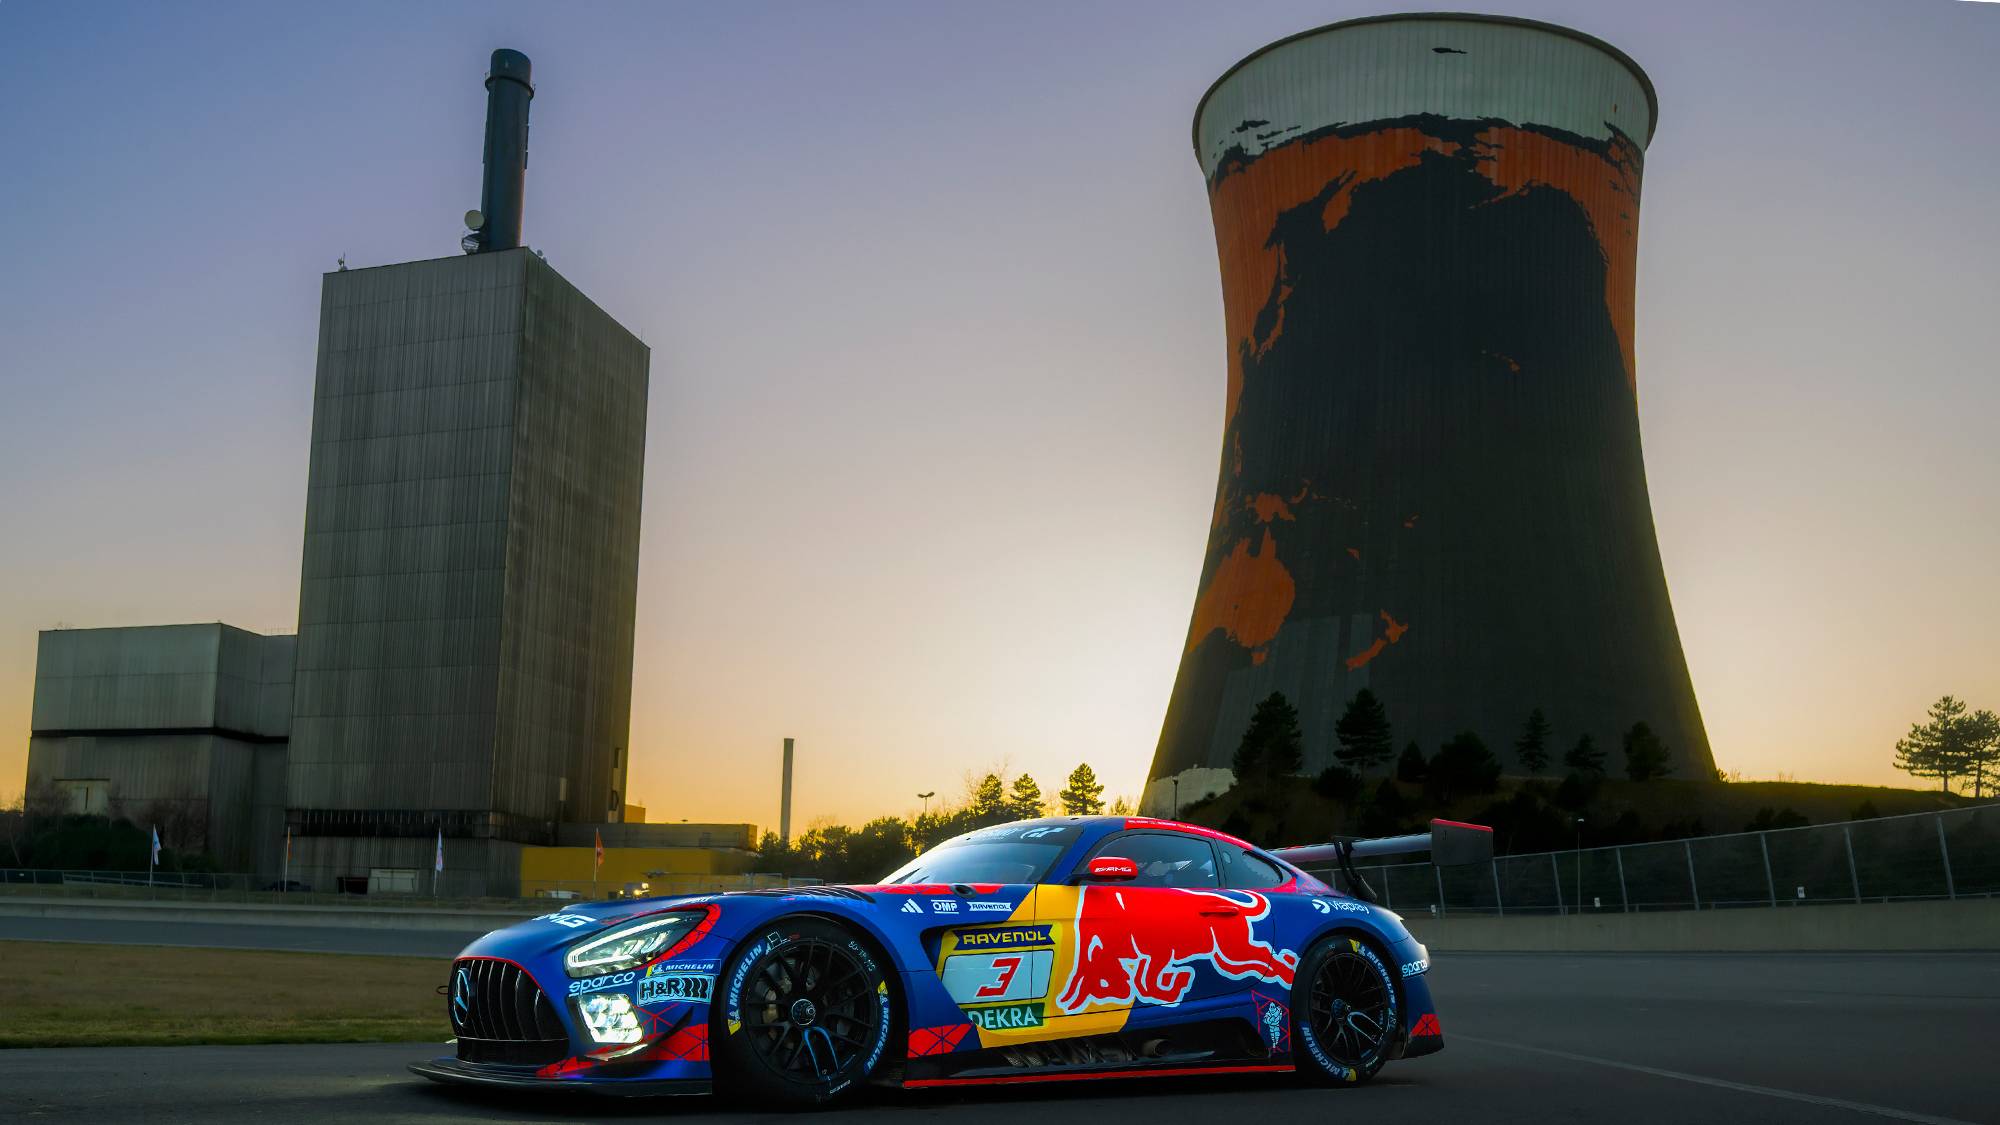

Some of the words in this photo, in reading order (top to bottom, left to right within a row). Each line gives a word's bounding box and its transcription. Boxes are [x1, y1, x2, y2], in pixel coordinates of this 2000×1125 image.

[932, 902, 958, 912] OMP
[963, 930, 1047, 945] RAVENOL
[665, 963, 715, 971] MICHELIN
[729, 944, 762, 1007] MICHELIN
[975, 956, 1024, 998] 3
[568, 971, 635, 996] sparco
[640, 977, 682, 1000] H&R
[1366, 952, 1397, 1008] MICHELIN
[967, 1006, 1039, 1029] DEKRA
[866, 1007, 889, 1070] MICHELIN
[1301, 1026, 1342, 1077] MICHELIN
